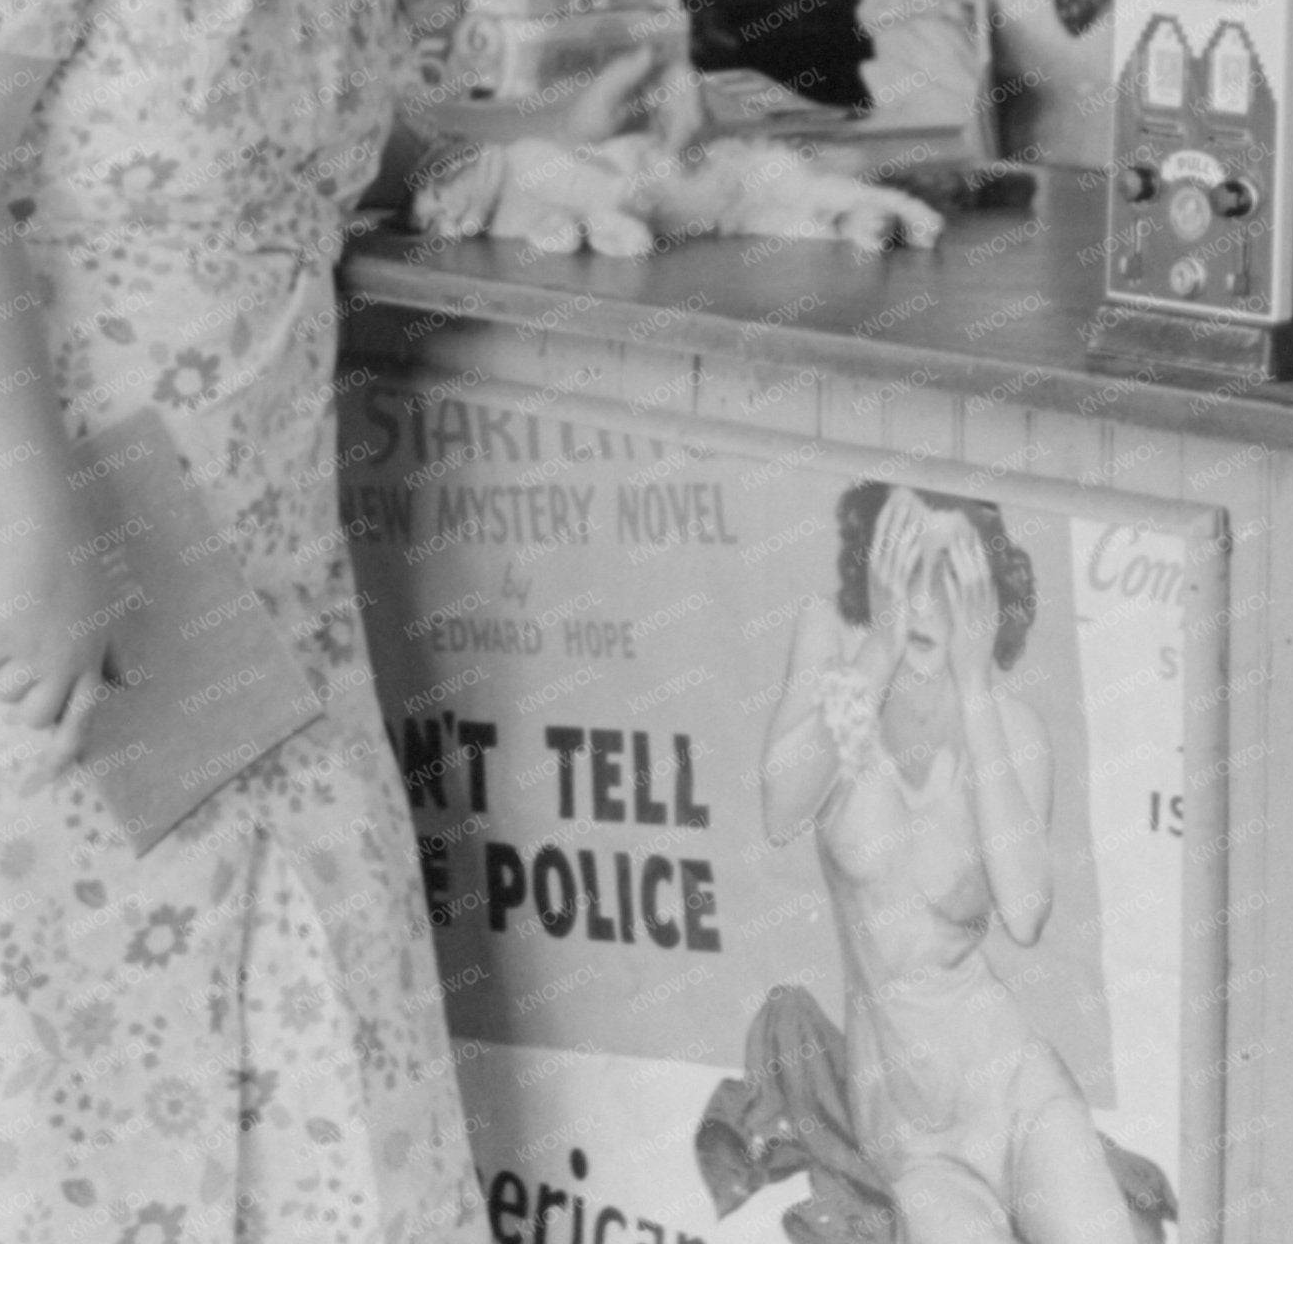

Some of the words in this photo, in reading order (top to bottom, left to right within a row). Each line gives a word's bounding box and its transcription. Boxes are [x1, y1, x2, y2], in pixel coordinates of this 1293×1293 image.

[436, 484, 596, 547] MYSTERY
[616, 484, 739, 547] NOVEL
[500, 561, 533, 610] by
[429, 613, 542, 656] EDWARD
[563, 617, 636, 659] HOPE
[545, 725, 713, 829] TELL
[486, 842, 723, 953] POLICE
